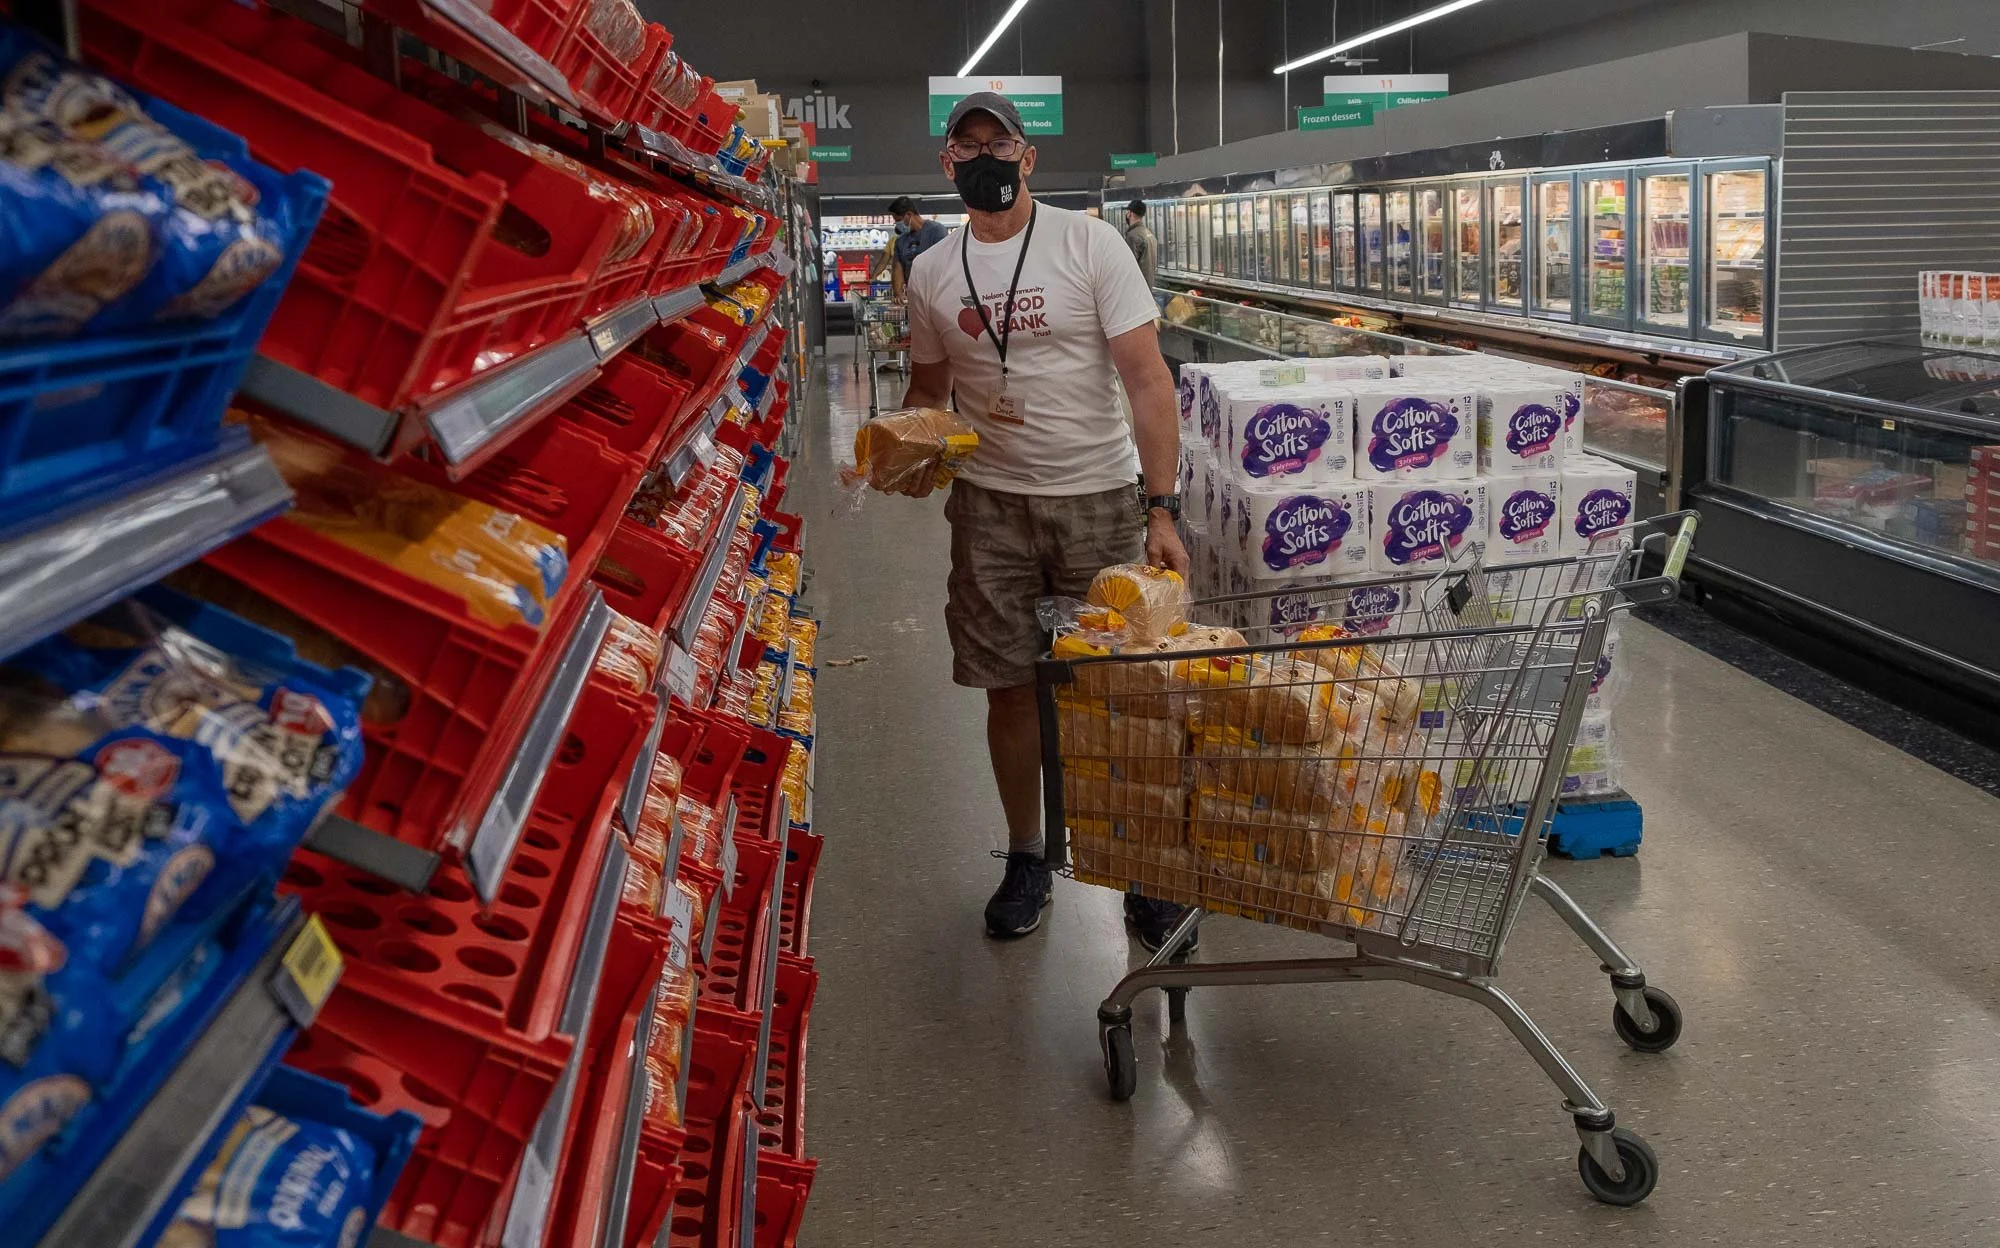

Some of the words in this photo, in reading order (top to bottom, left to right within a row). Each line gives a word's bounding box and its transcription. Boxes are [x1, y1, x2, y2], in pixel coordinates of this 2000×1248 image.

[989, 80, 1003, 90] 10
[1380, 80, 1392, 88] 11
[1332, 112, 1361, 122] dessert
[1000, 184, 1012, 195] KIA
[1002, 193, 1012, 203] ORA
[982, 292, 1004, 301] Nelson
[1006, 286, 1044, 296] Cmmunity
[994, 296, 1044, 316] FOOD
[996, 313, 1048, 335] BANK
[1254, 412, 1312, 440] Cotton
[1383, 406, 1440, 433] Cotton
[1516, 412, 1551, 430] Cotton
[1385, 427, 1436, 456] Softs
[1517, 426, 1548, 445] Softs
[1259, 433, 1309, 462] Softs
[1398, 498, 1454, 526] Cotton
[1509, 498, 1545, 516] Cotton
[1584, 497, 1621, 515] Cotton
[1276, 504, 1332, 532] Cotton
[1510, 512, 1542, 531] Softs
[1586, 511, 1618, 529] Softs
[1280, 524, 1330, 555] Softs
[1401, 519, 1451, 548] Softs
